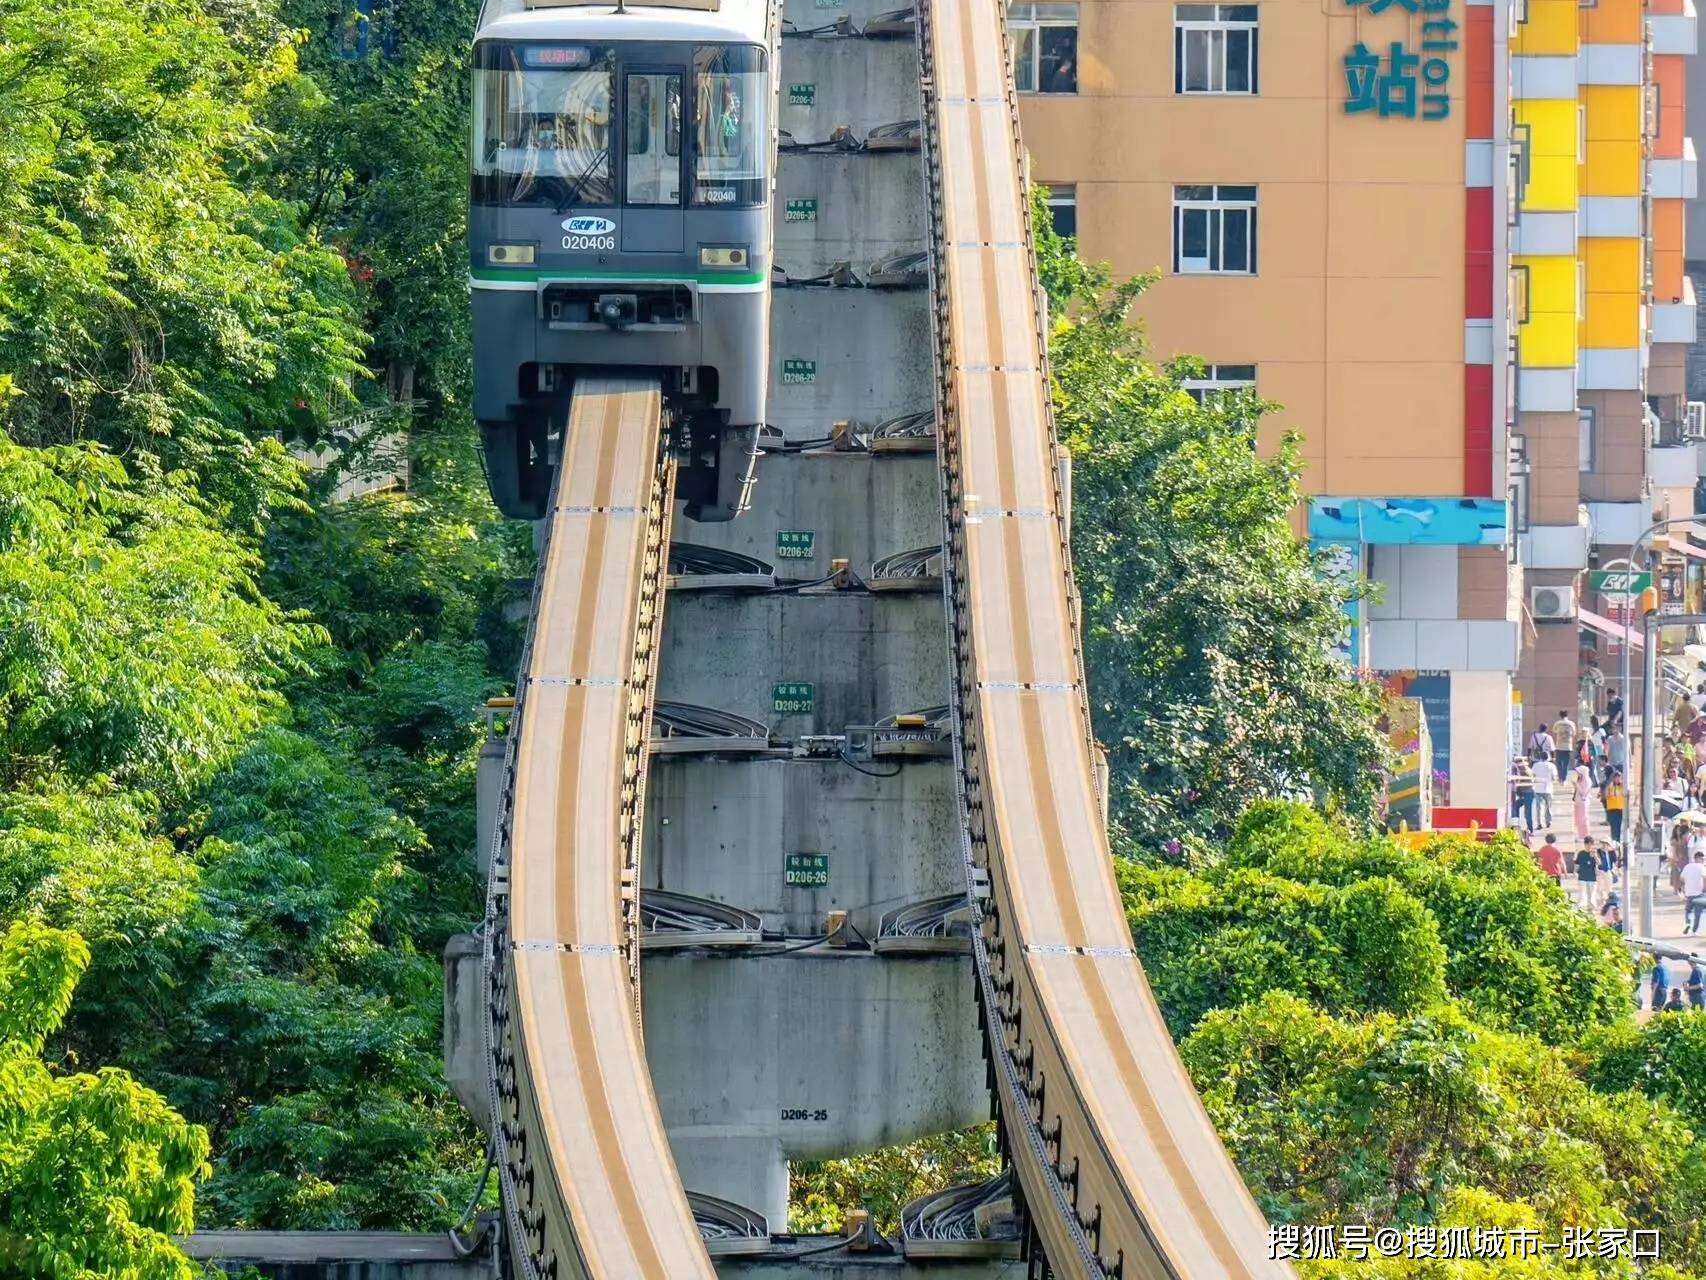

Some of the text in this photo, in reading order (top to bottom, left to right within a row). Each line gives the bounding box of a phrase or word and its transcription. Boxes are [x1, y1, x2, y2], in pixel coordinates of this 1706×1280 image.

[561, 235, 615, 250] 020406
[779, 546, 813, 558] D206-28
[774, 700, 812, 711] D206-27
[786, 870, 827, 884] D206-26
[781, 1109, 828, 1121] D206-25
